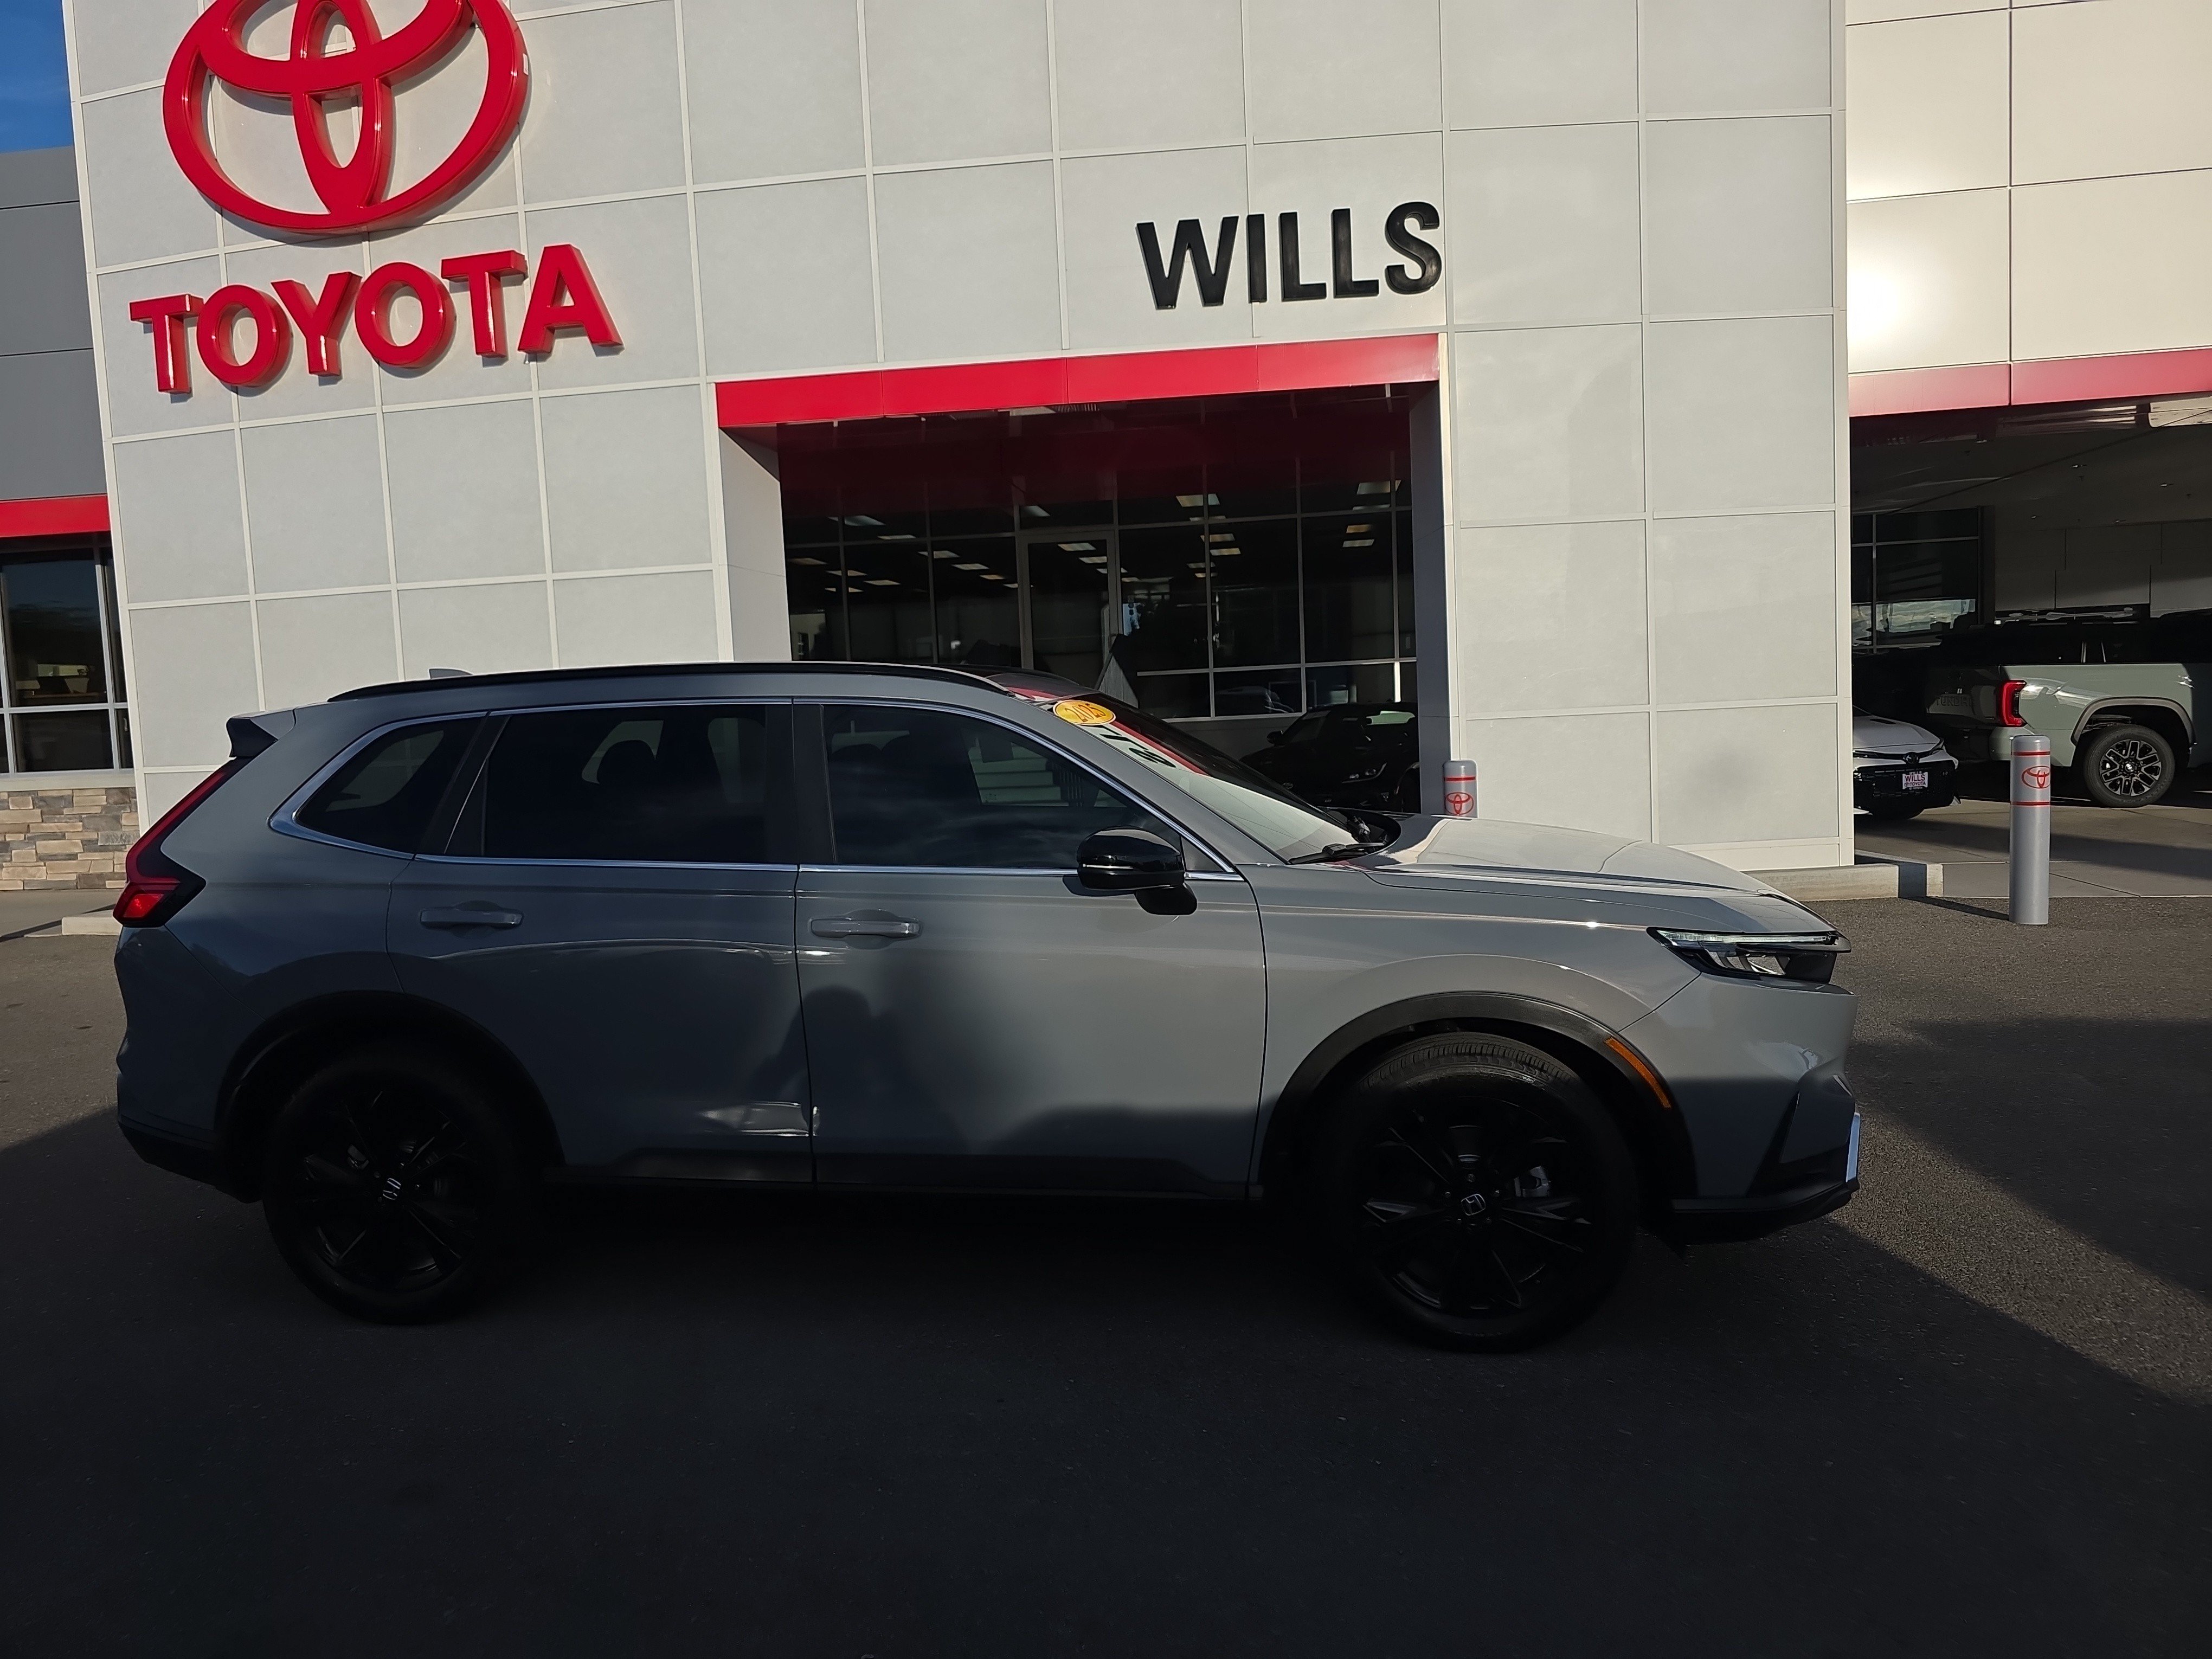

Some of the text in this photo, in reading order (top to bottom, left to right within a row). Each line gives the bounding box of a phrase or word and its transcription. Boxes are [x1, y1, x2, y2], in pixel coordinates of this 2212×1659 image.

[1136, 201, 1442, 310] WILLS
[129, 244, 623, 395] TOYOTA
[1064, 703, 1106, 723] 2025
